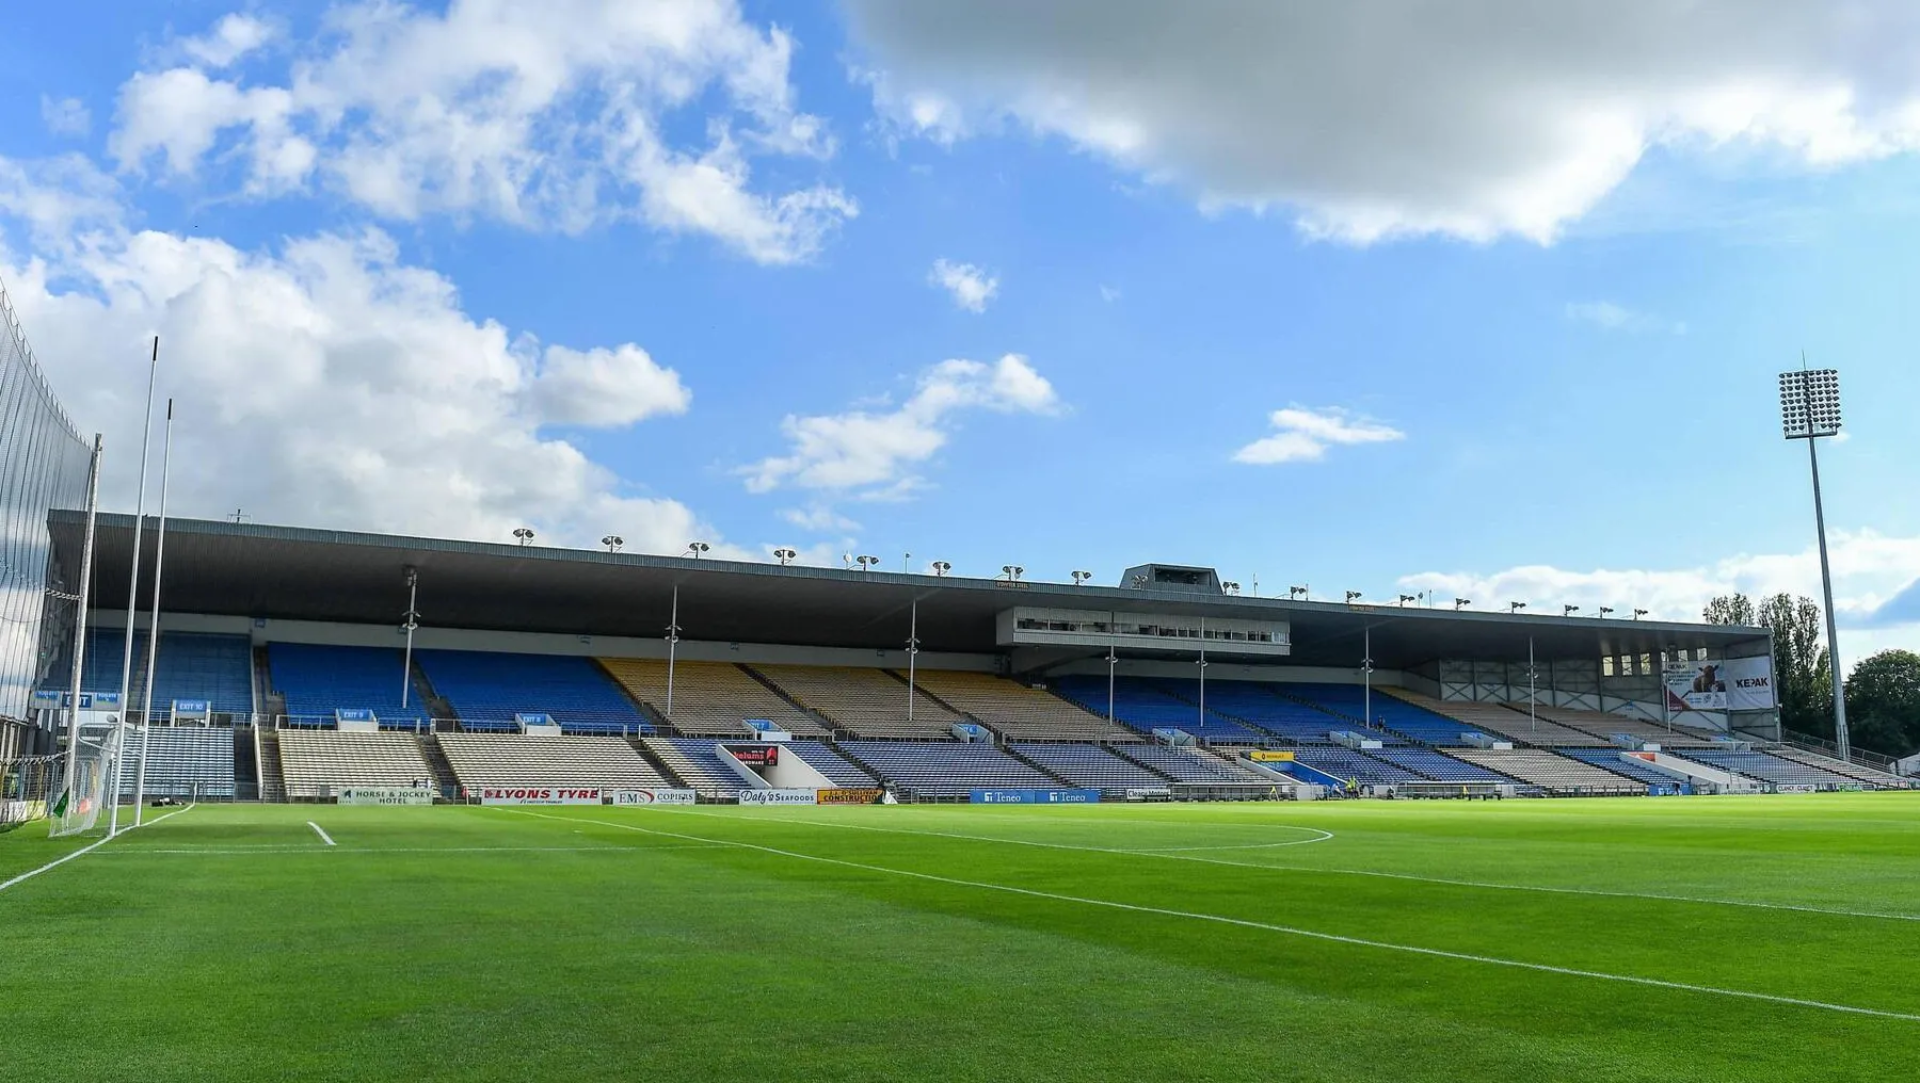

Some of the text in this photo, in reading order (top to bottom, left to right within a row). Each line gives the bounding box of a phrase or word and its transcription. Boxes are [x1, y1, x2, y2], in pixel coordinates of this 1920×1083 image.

[1736, 677, 1769, 688] KEPAK
[66, 696, 89, 706] EIT
[495, 789, 600, 799] LYONS TYRE
[619, 792, 645, 803] EMS
[657, 793, 694, 801] COPIERS
[740, 790, 774, 804] Daly's
[823, 794, 878, 802] CONSTRUCTIO
[995, 791, 1021, 802] Teneo
[1060, 791, 1086, 802] Teneo
